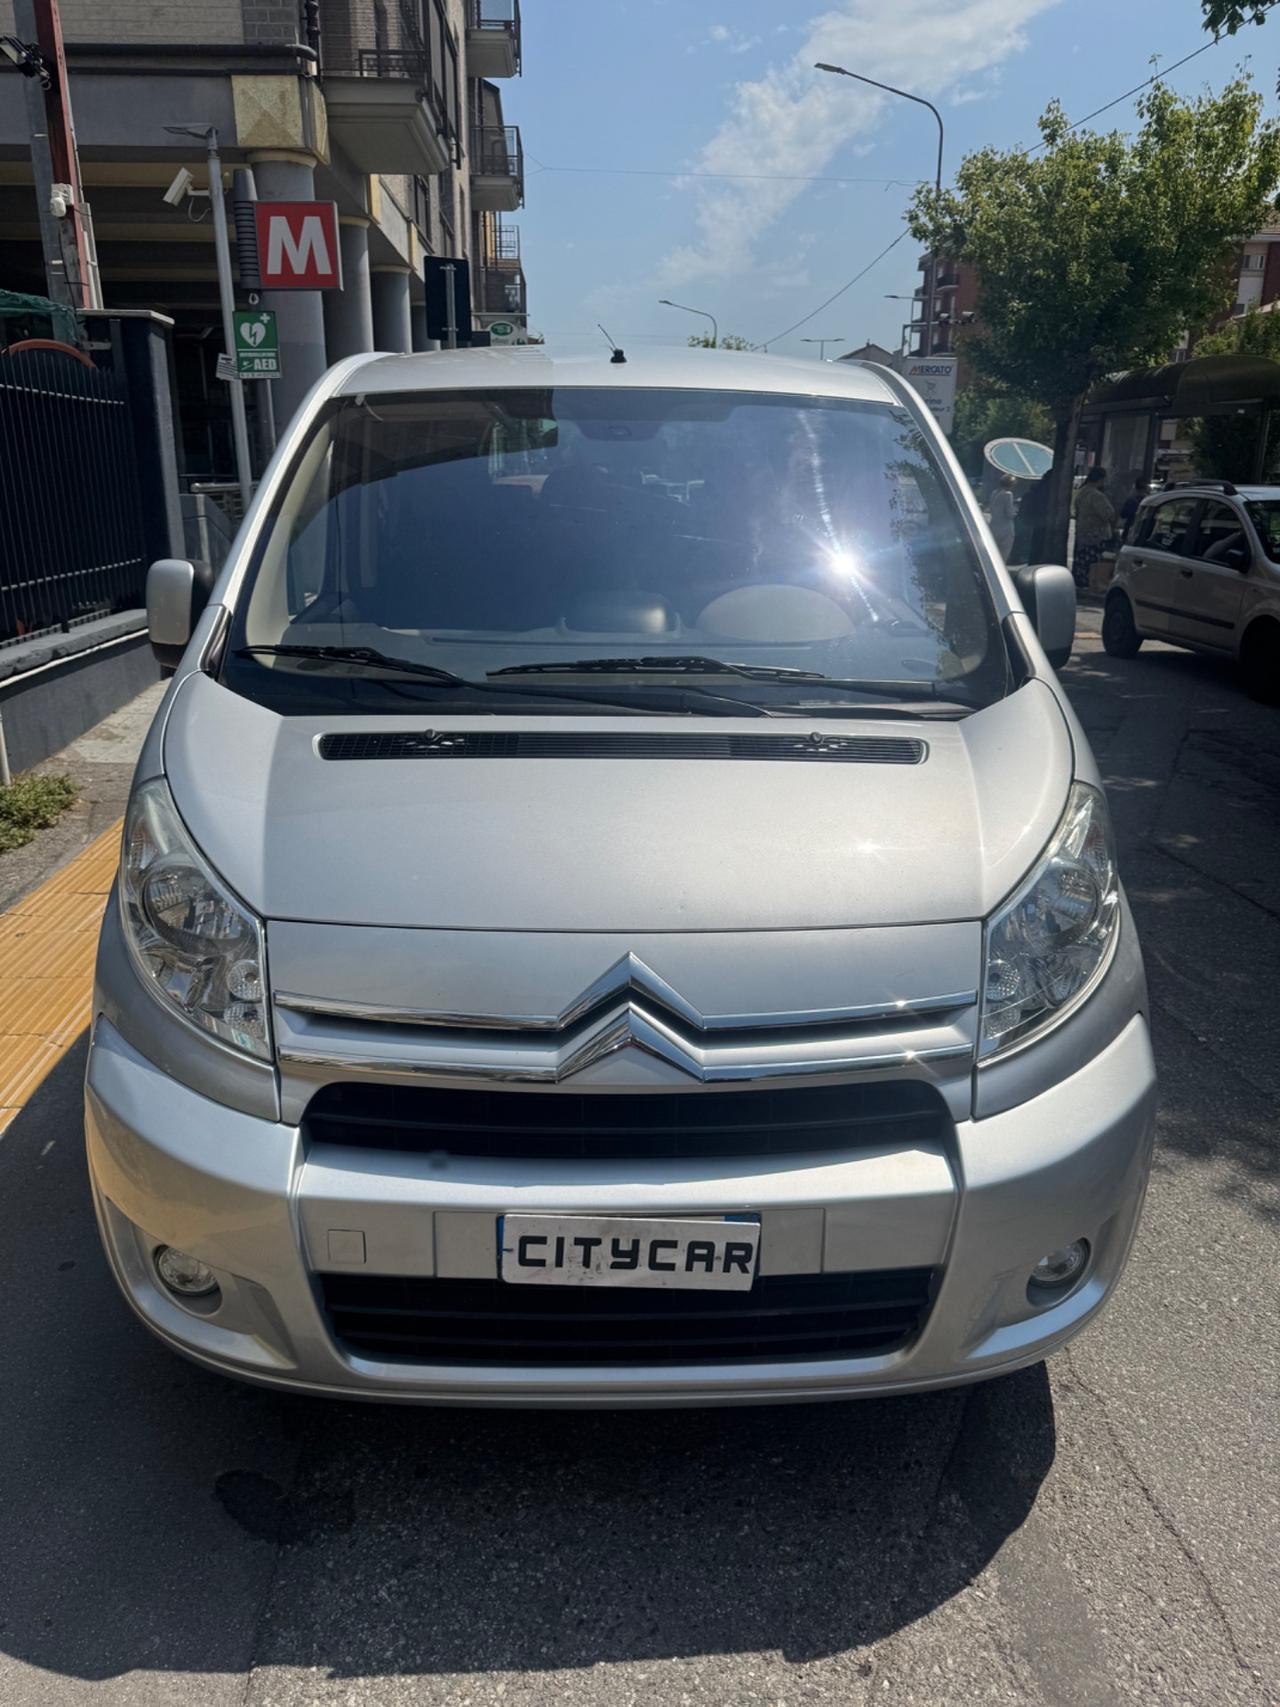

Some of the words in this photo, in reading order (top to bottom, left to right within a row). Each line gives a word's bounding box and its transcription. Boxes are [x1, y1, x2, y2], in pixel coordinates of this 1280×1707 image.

[267, 216, 333, 275] M
[254, 358, 277, 371] AED
[909, 365, 953, 376] MERCATO
[518, 1236, 754, 1274] CITYCAR
